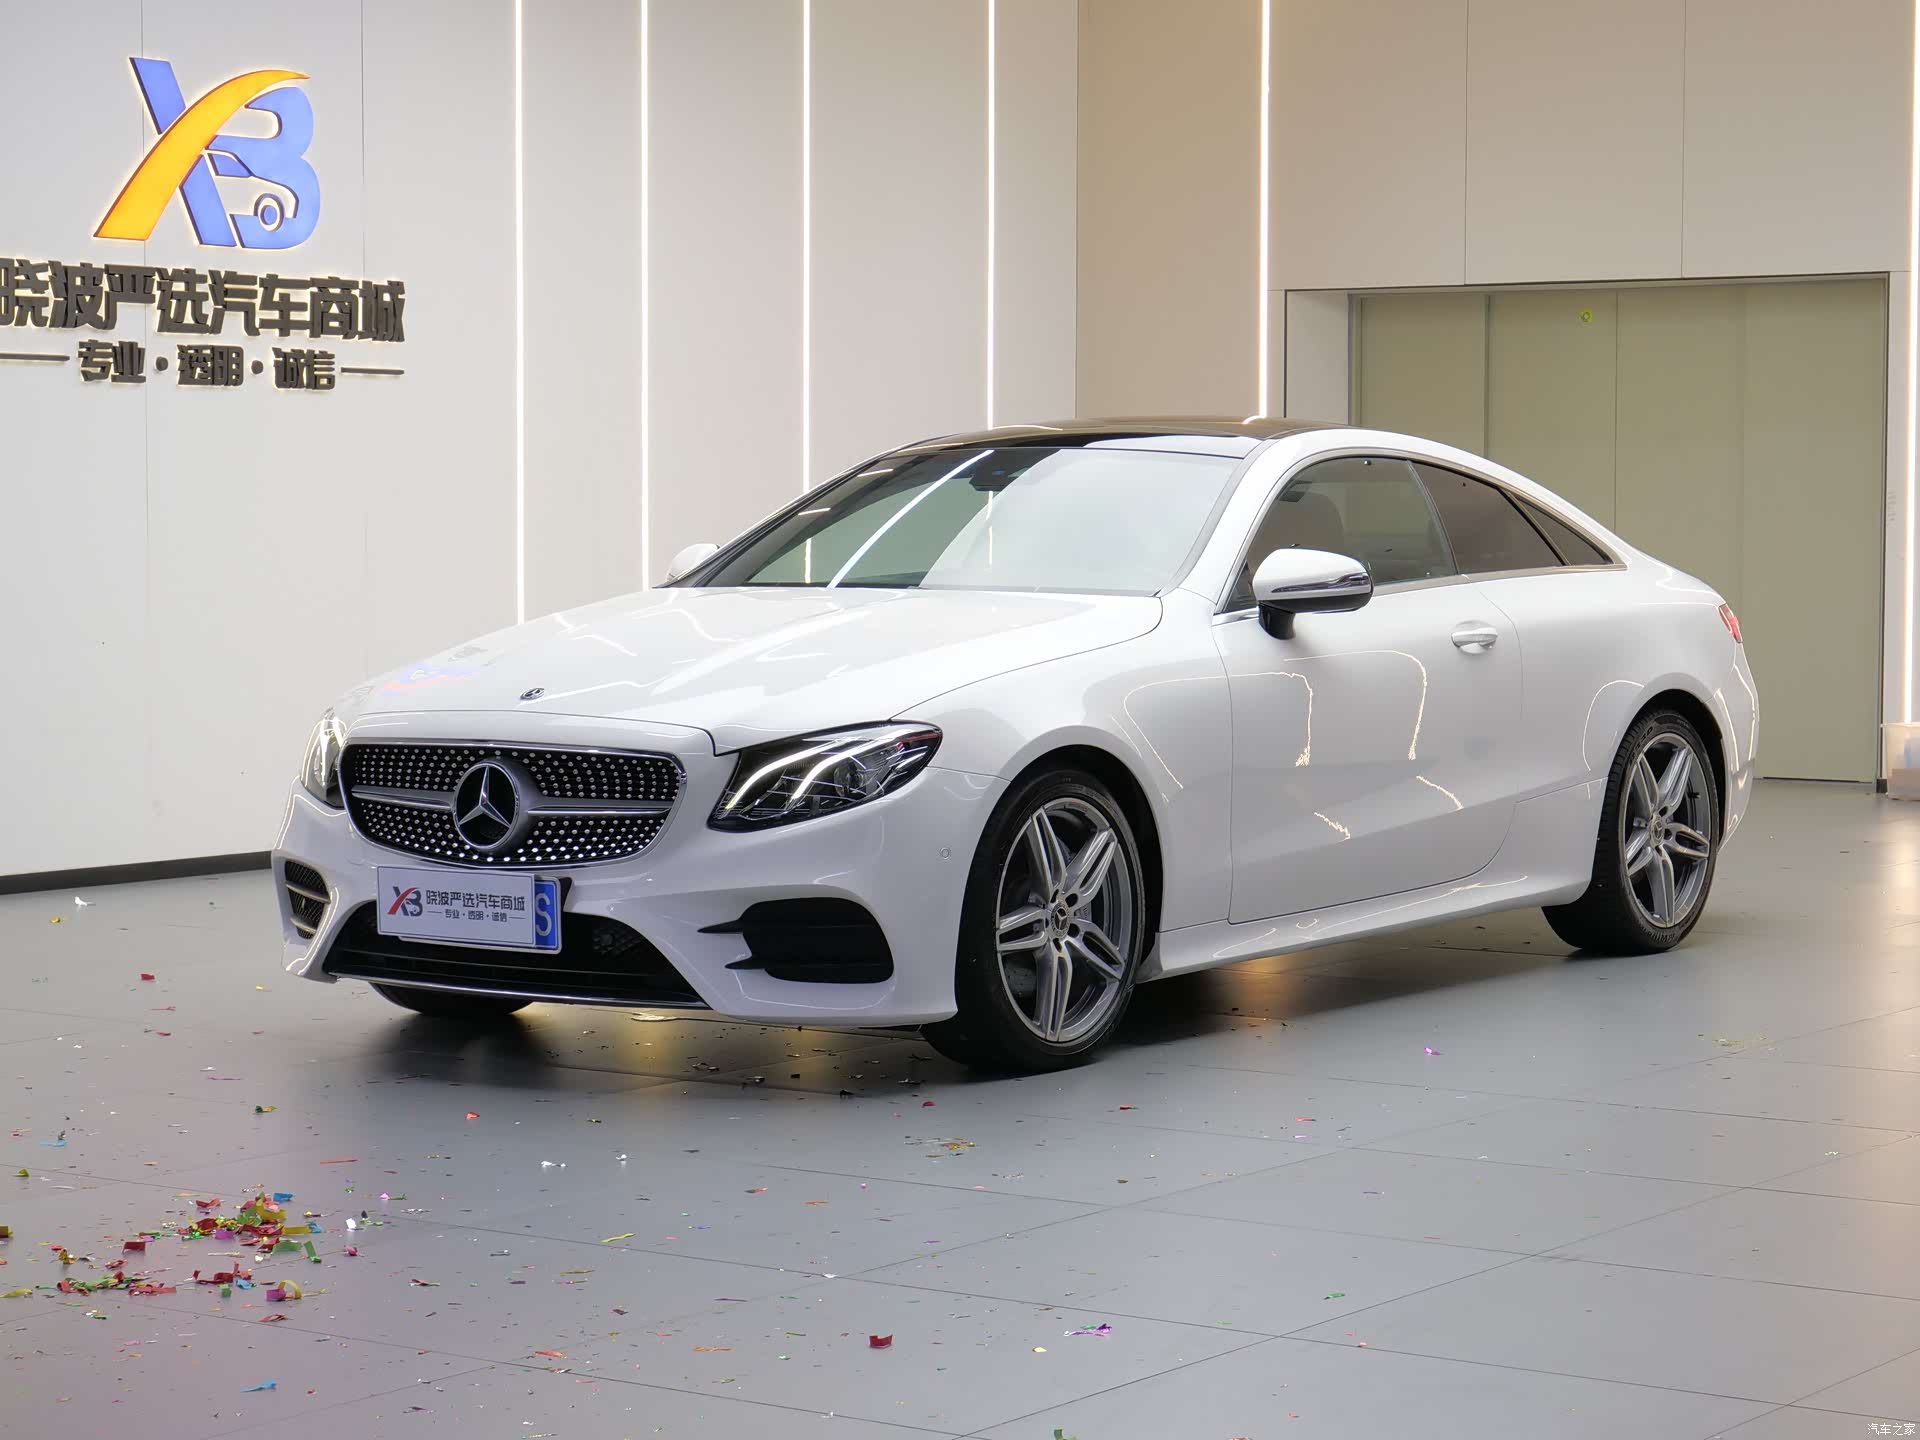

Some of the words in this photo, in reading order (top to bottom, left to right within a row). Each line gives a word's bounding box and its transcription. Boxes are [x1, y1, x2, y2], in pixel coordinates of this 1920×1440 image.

[0, 258, 405, 342] 晓波严选汽车商城
[425, 889, 525, 911] 晓波严选汽车商城
